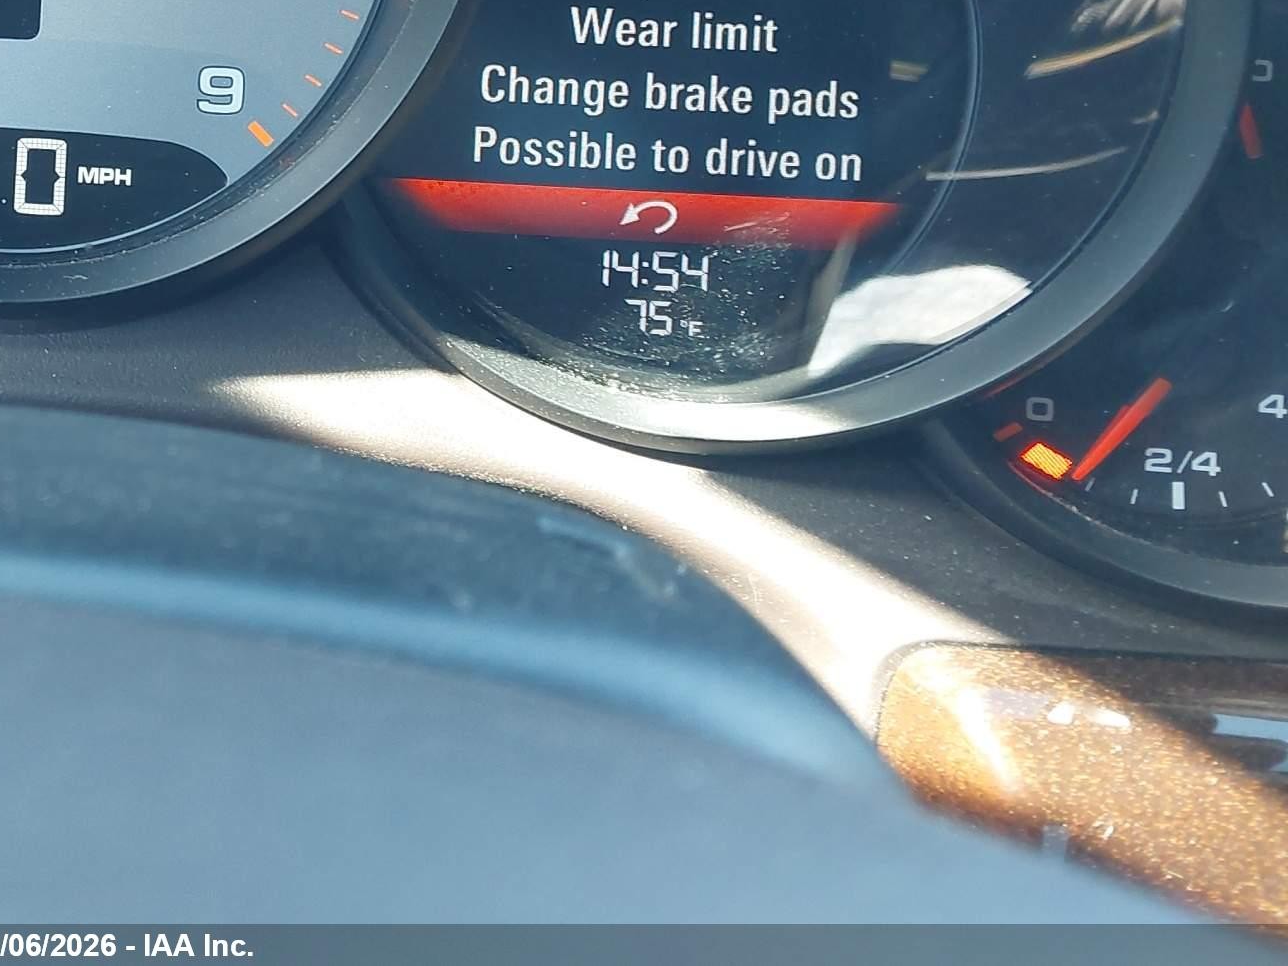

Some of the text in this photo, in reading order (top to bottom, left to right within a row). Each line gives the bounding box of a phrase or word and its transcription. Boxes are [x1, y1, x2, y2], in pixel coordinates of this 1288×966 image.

[570, 6, 778, 52] Wear limit
[196, 65, 245, 115] 9
[481, 65, 860, 123] Change brake pads
[473, 126, 862, 181] Possible to drive on
[13, 137, 67, 216] 0
[77, 165, 132, 187] MPH
[602, 250, 709, 293] 14:54
[624, 299, 672, 336] 75
[1025, 397, 1055, 421] 0
[1144, 447, 1222, 477] 2/4
